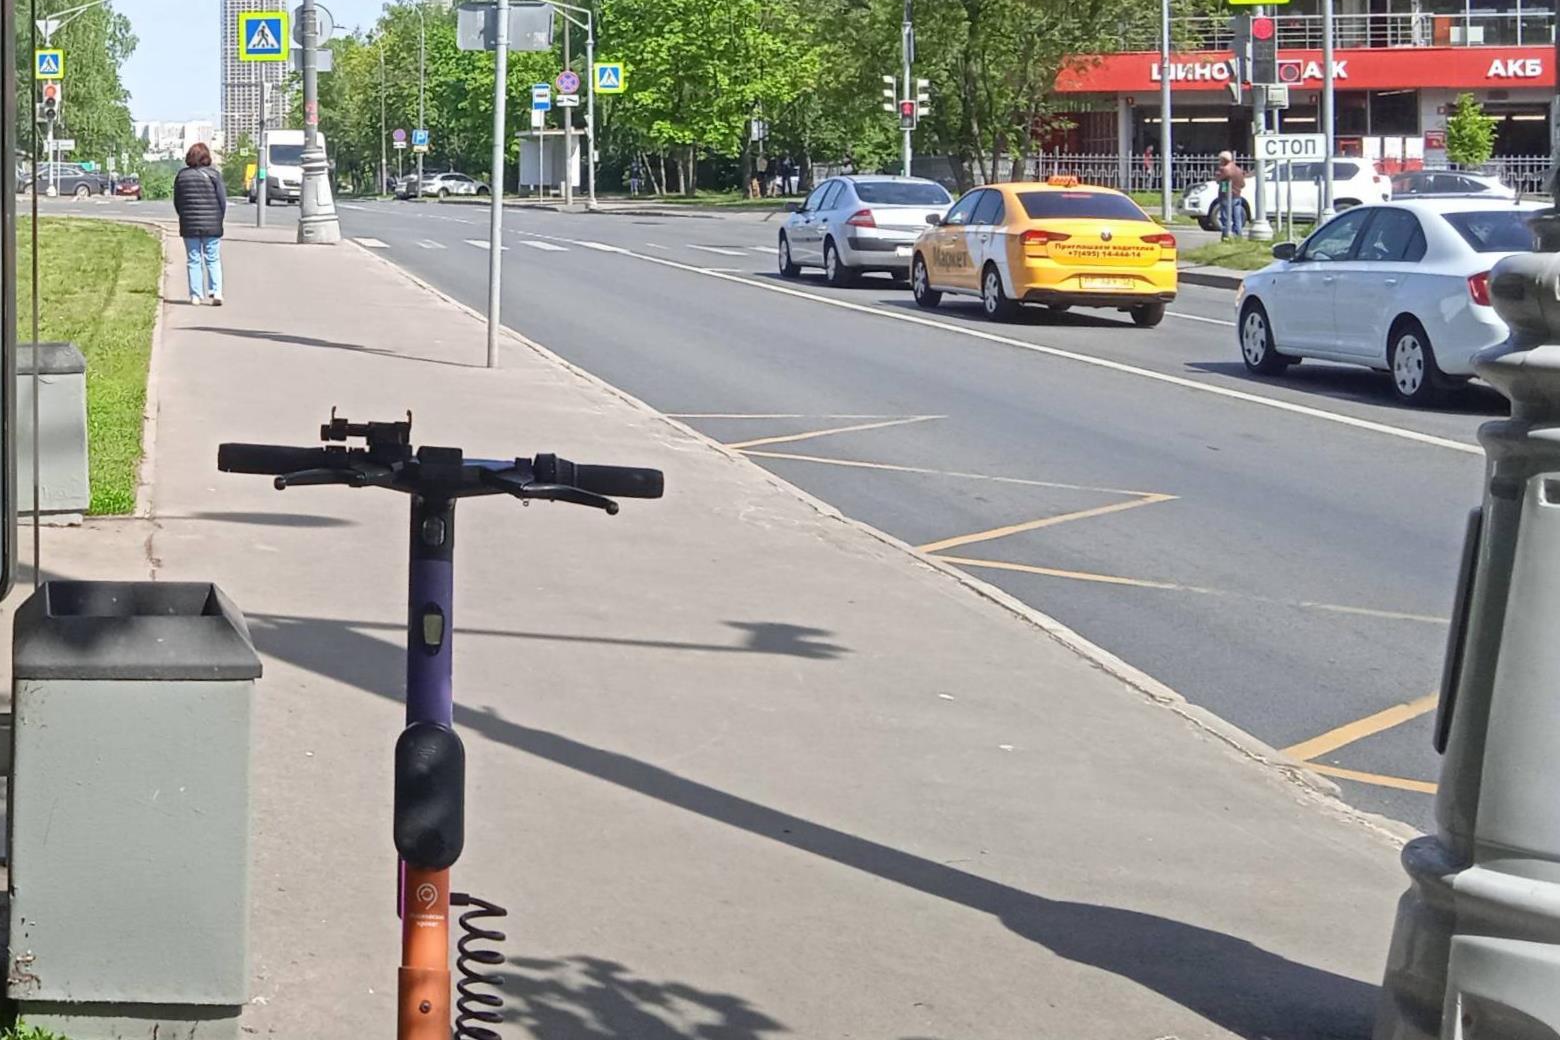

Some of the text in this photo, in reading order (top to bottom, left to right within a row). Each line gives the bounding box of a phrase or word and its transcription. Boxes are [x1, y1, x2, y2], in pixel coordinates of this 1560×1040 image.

[1487, 58, 1543, 78] АКБ
[1265, 138, 1317, 155] СТОП
[1055, 243, 1110, 251] Приглашаем
